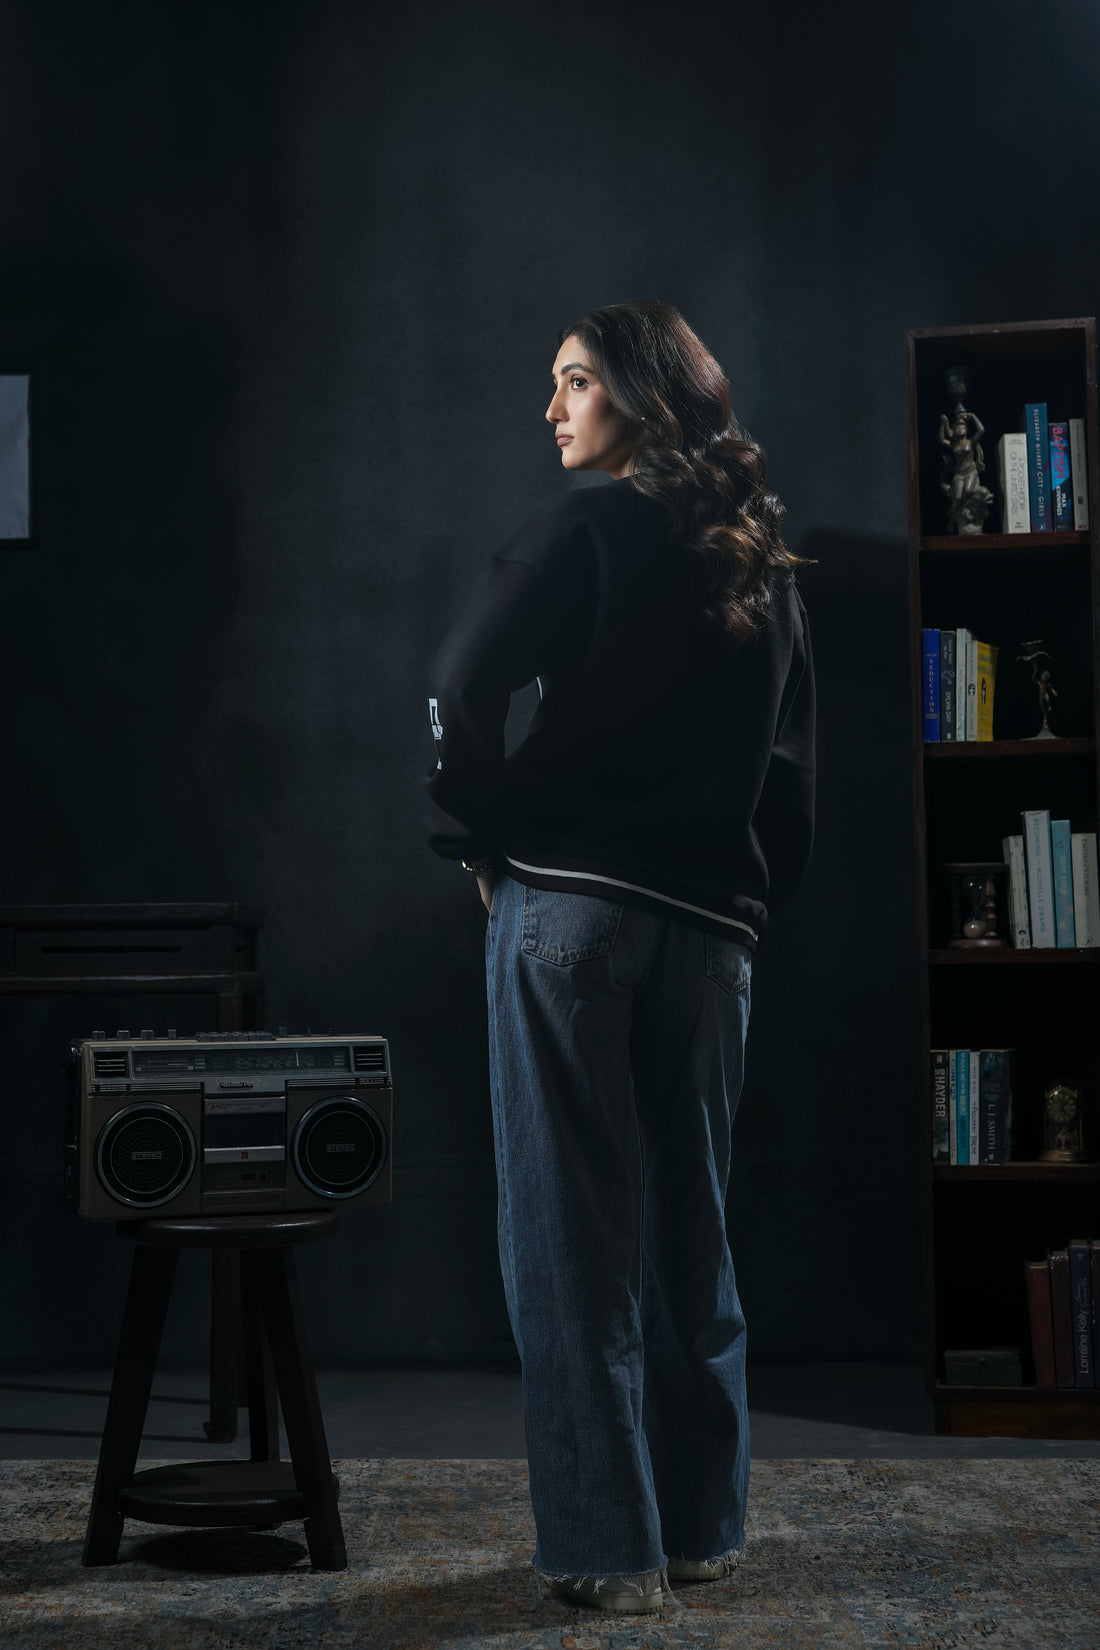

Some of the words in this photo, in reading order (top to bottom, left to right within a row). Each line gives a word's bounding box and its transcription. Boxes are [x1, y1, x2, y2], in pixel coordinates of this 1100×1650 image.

[1052, 427, 1066, 479] BAPTISM
[1033, 817, 1041, 857] BECOMING
[1036, 867, 1044, 903] MICHELLE
[1038, 905, 1046, 933] OBAMA
[934, 1076, 946, 1118] HAYDER
[987, 1120, 996, 1150] SMITH
[1077, 1309, 1088, 1333] Kelly
[1077, 1334, 1089, 1374] Lorraine
